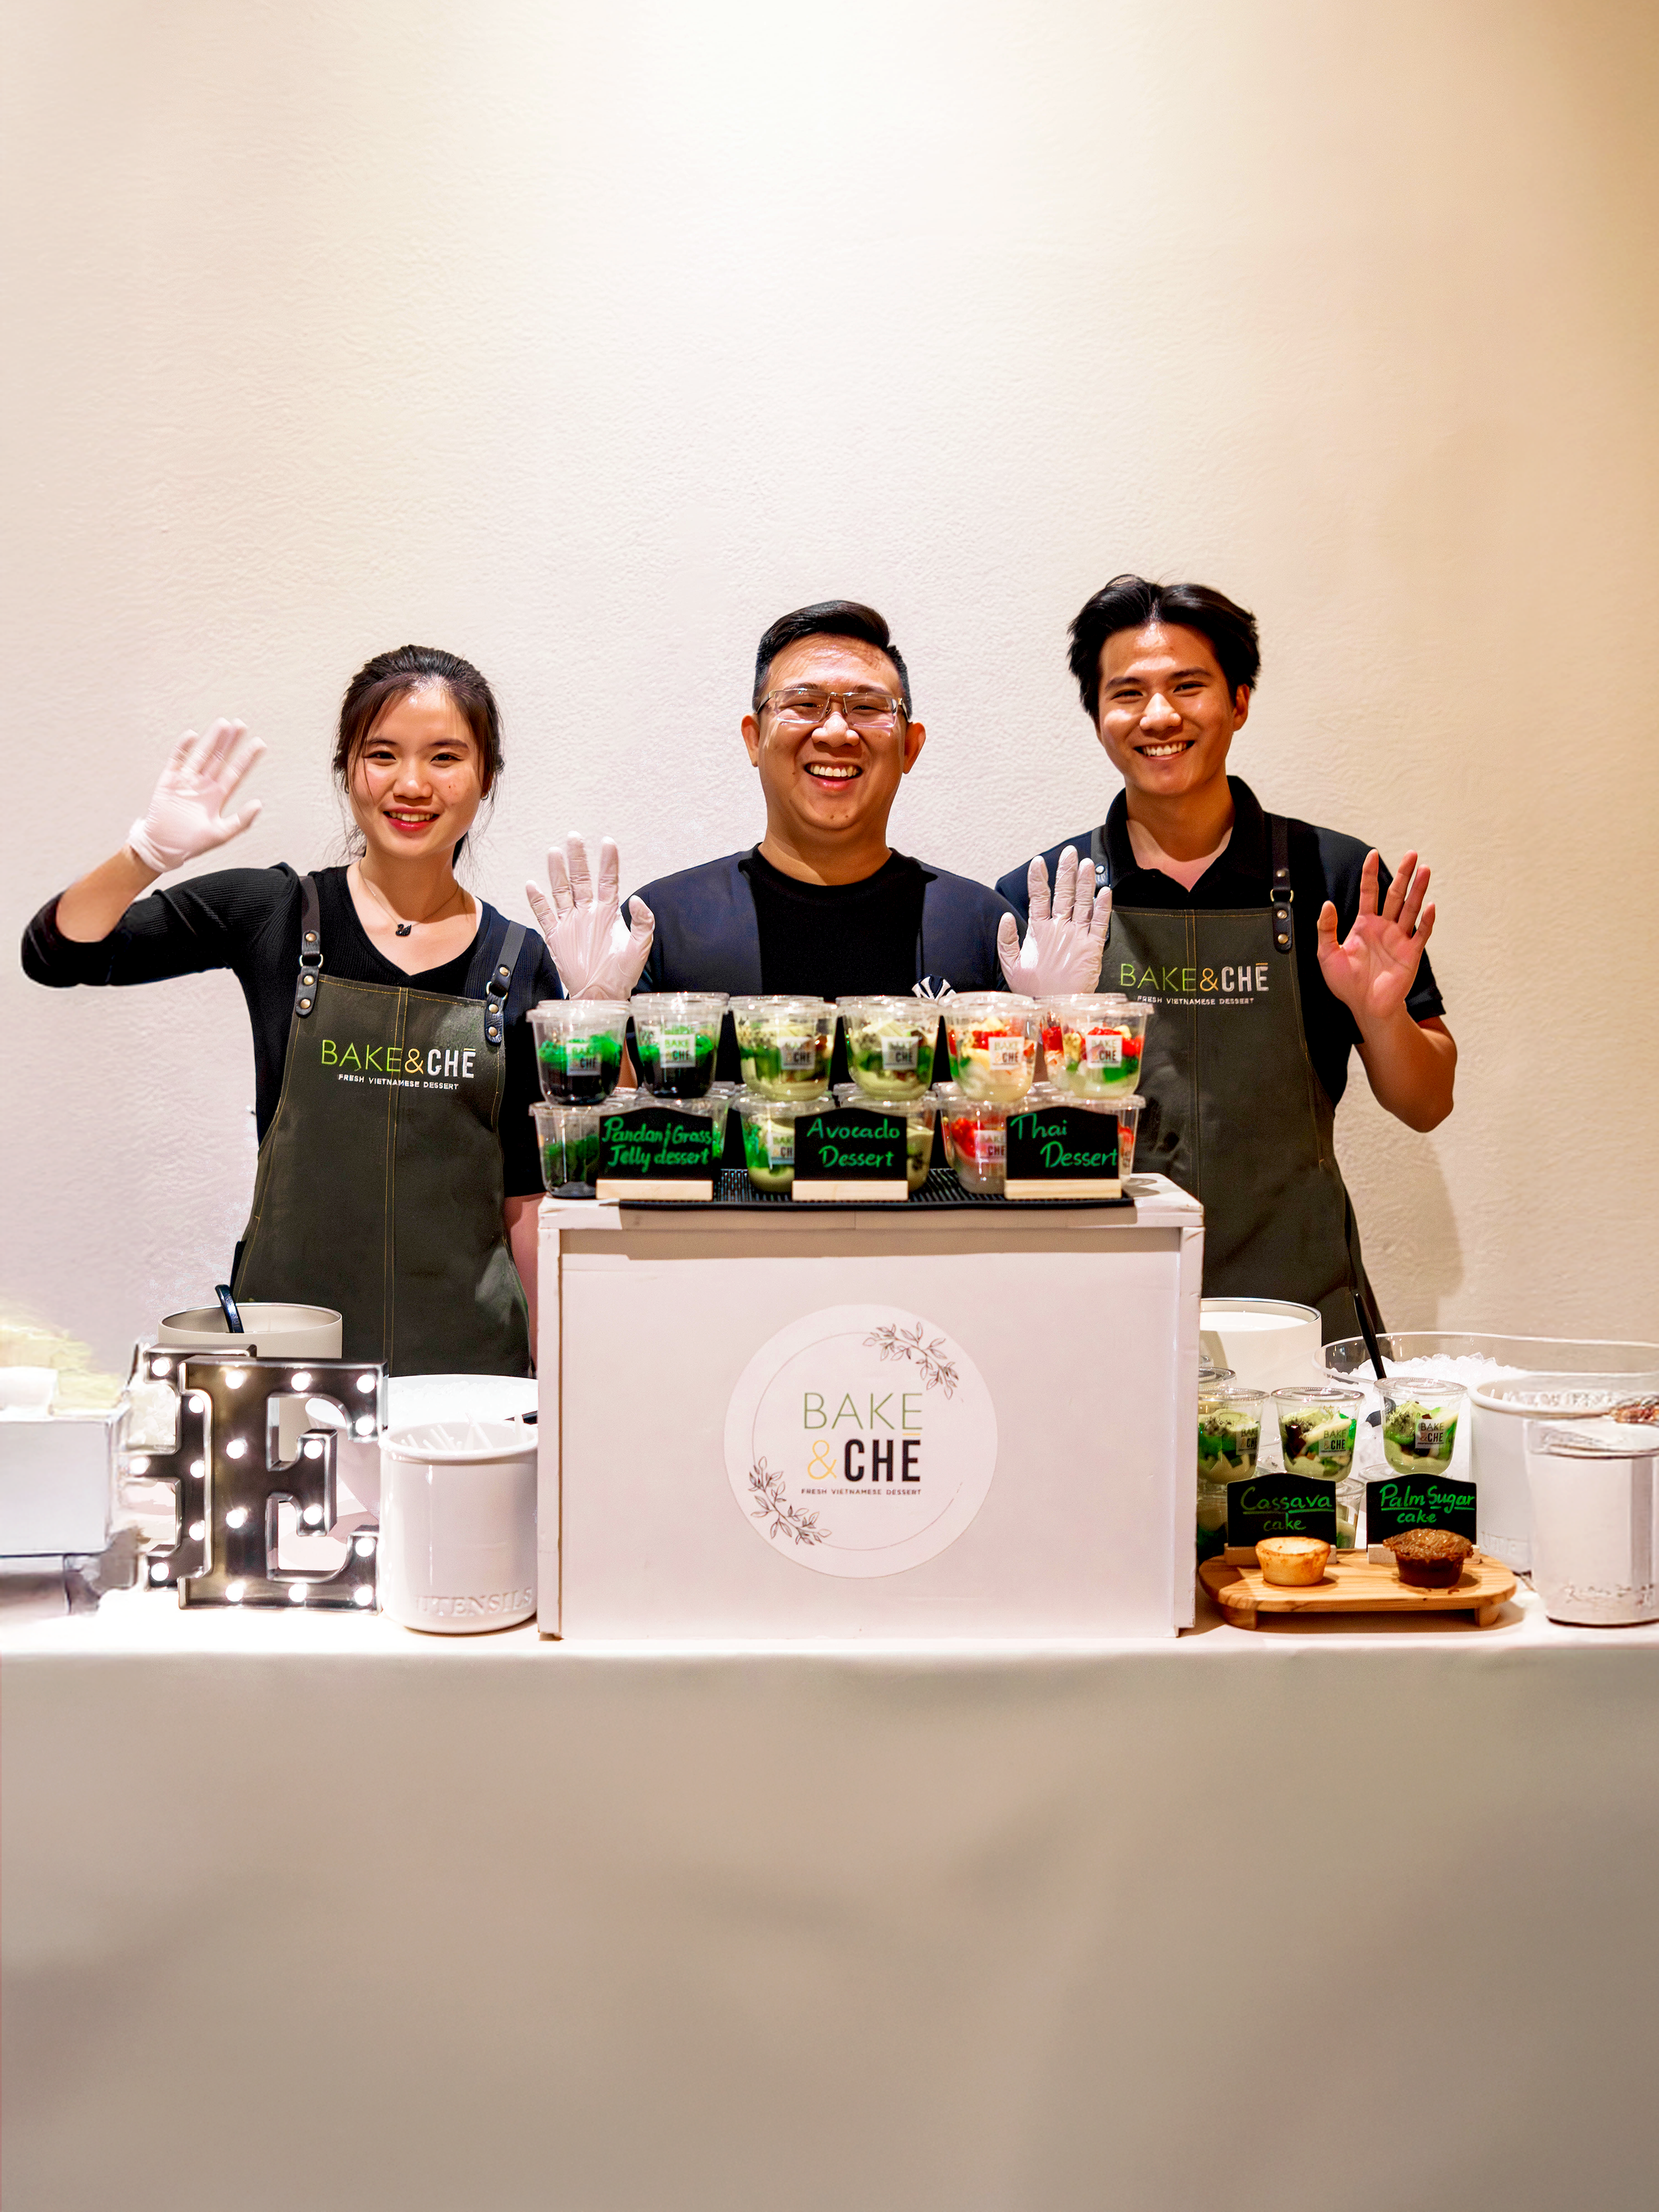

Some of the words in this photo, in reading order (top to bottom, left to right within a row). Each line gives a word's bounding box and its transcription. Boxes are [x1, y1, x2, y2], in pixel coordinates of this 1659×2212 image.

[338, 1074, 364, 1083] FRESH
[368, 1076, 420, 1088] VIETNAMESE
[423, 1081, 459, 1090] DESSERT
[806, 1117, 901, 1140] Avocado
[1010, 1113, 1067, 1140] Thai
[607, 1144, 652, 1173] Jelly
[654, 1148, 709, 1165] dessert
[818, 1145, 894, 1168] Dessert
[1040, 1140, 1118, 1168] Dessert
[804, 1392, 922, 1430] BAKE
[1324, 1429, 1346, 1439] BAKE
[1421, 1422, 1444, 1432] BAKE
[1240, 1486, 1333, 1511] Cassava
[1380, 1483, 1425, 1507] Palm
[1427, 1485, 1475, 1514] Sugar
[1263, 1512, 1307, 1532] cake
[1396, 1509, 1437, 1523] cake
